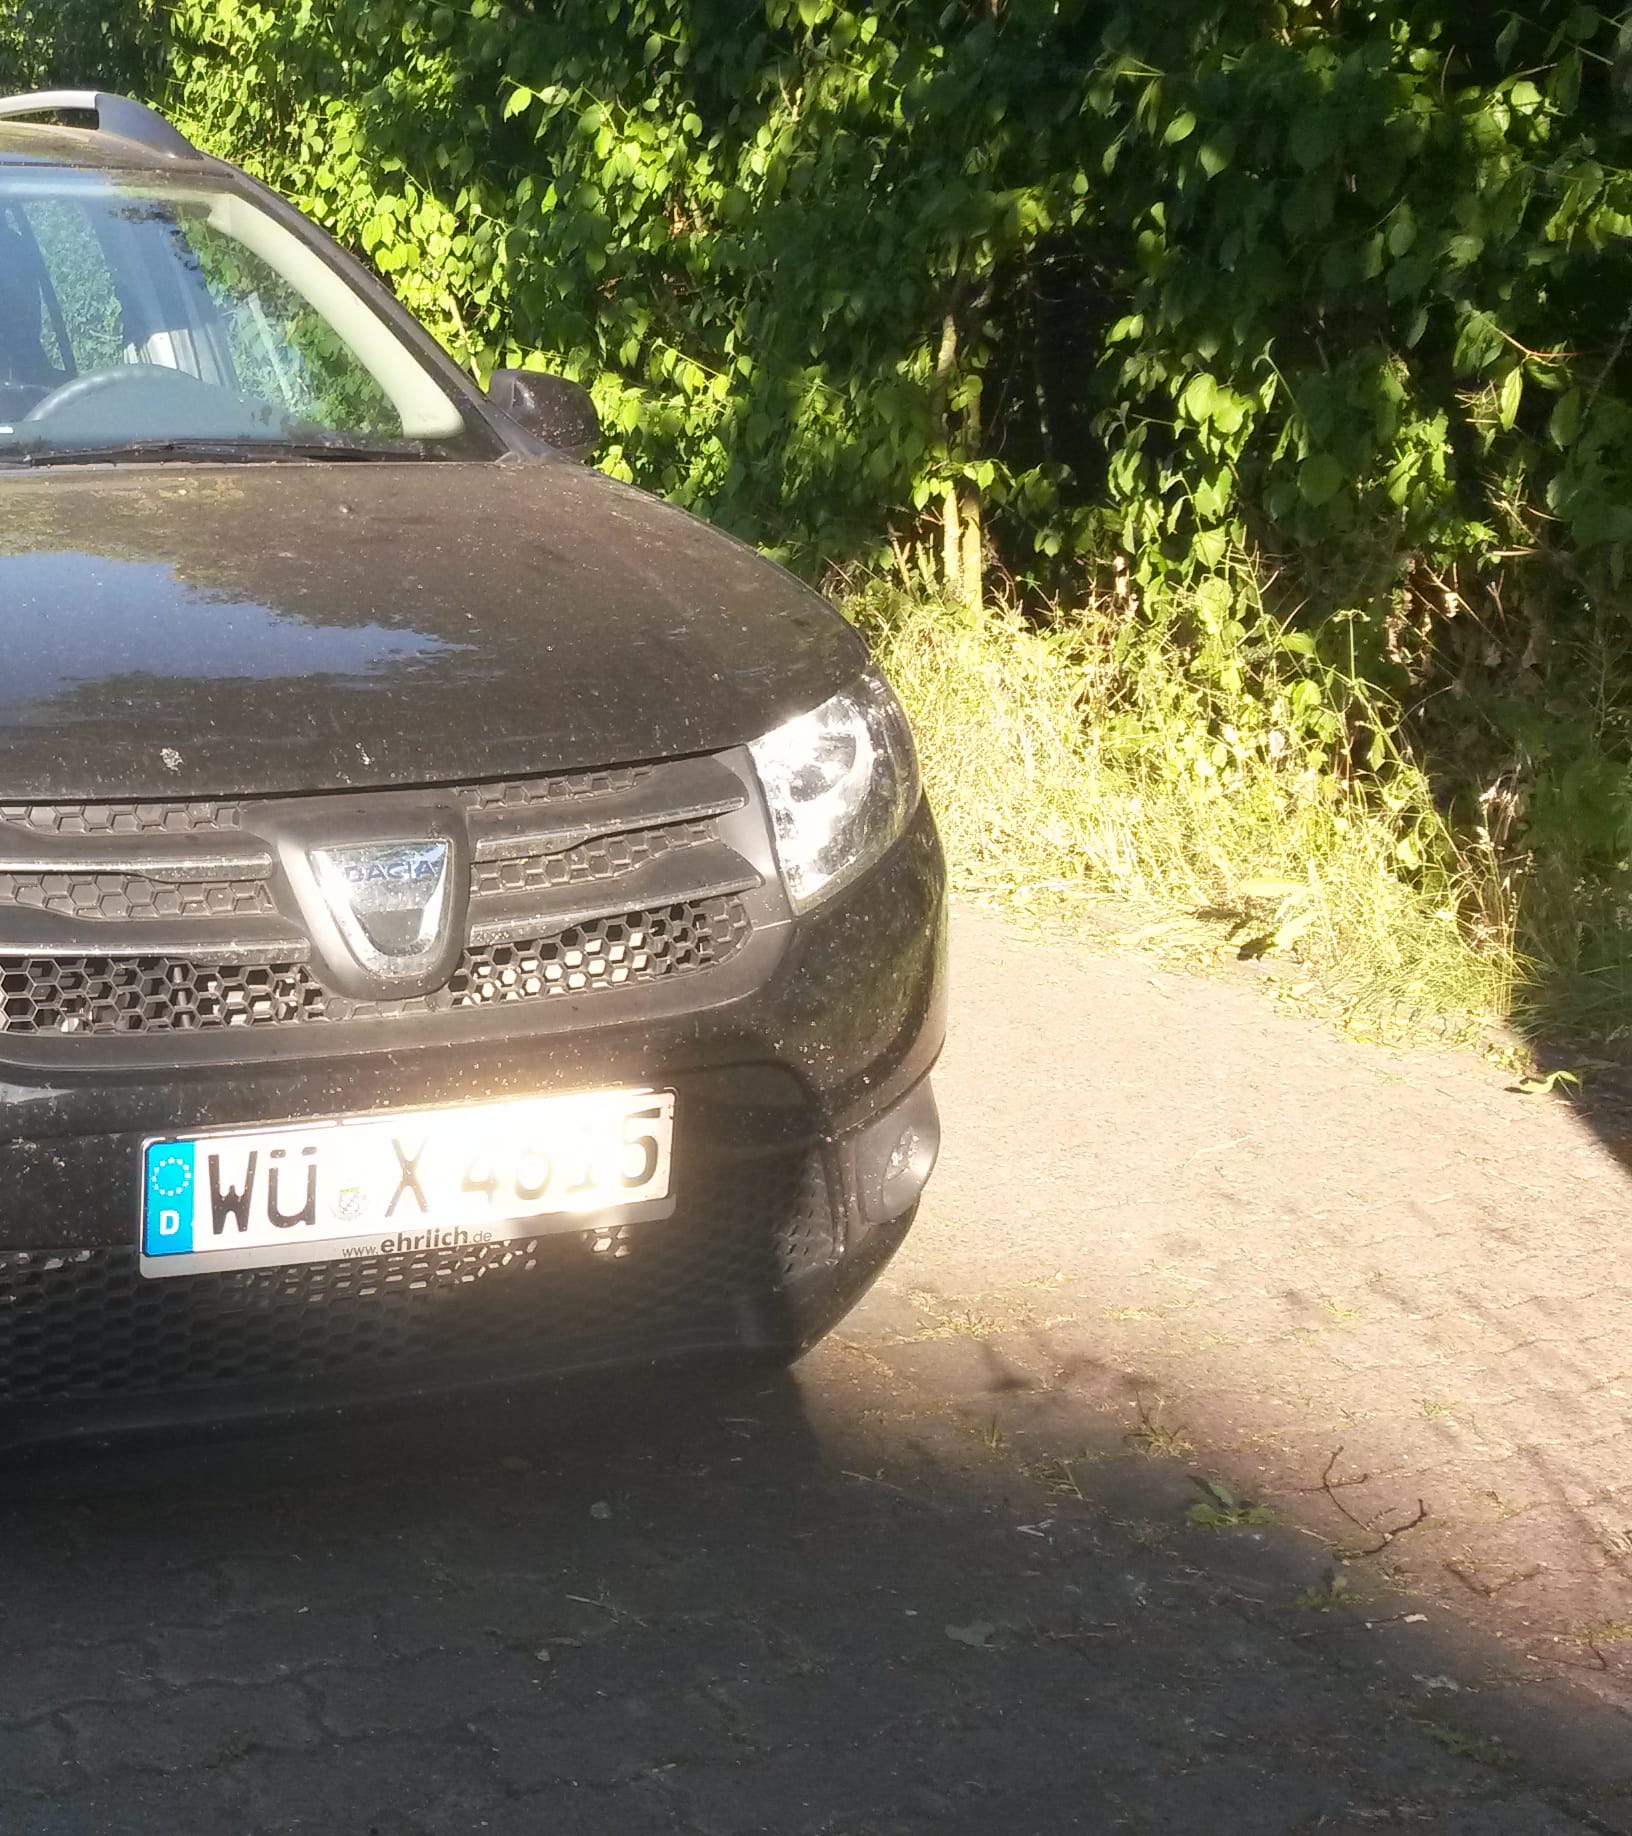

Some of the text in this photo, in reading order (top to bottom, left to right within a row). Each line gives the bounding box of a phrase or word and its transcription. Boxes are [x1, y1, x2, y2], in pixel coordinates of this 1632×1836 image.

[344, 859, 437, 883] DACIA
[383, 1136, 431, 1218] X
[159, 1209, 180, 1236] D
[341, 1225, 493, 1258] www.ehrlich.de
